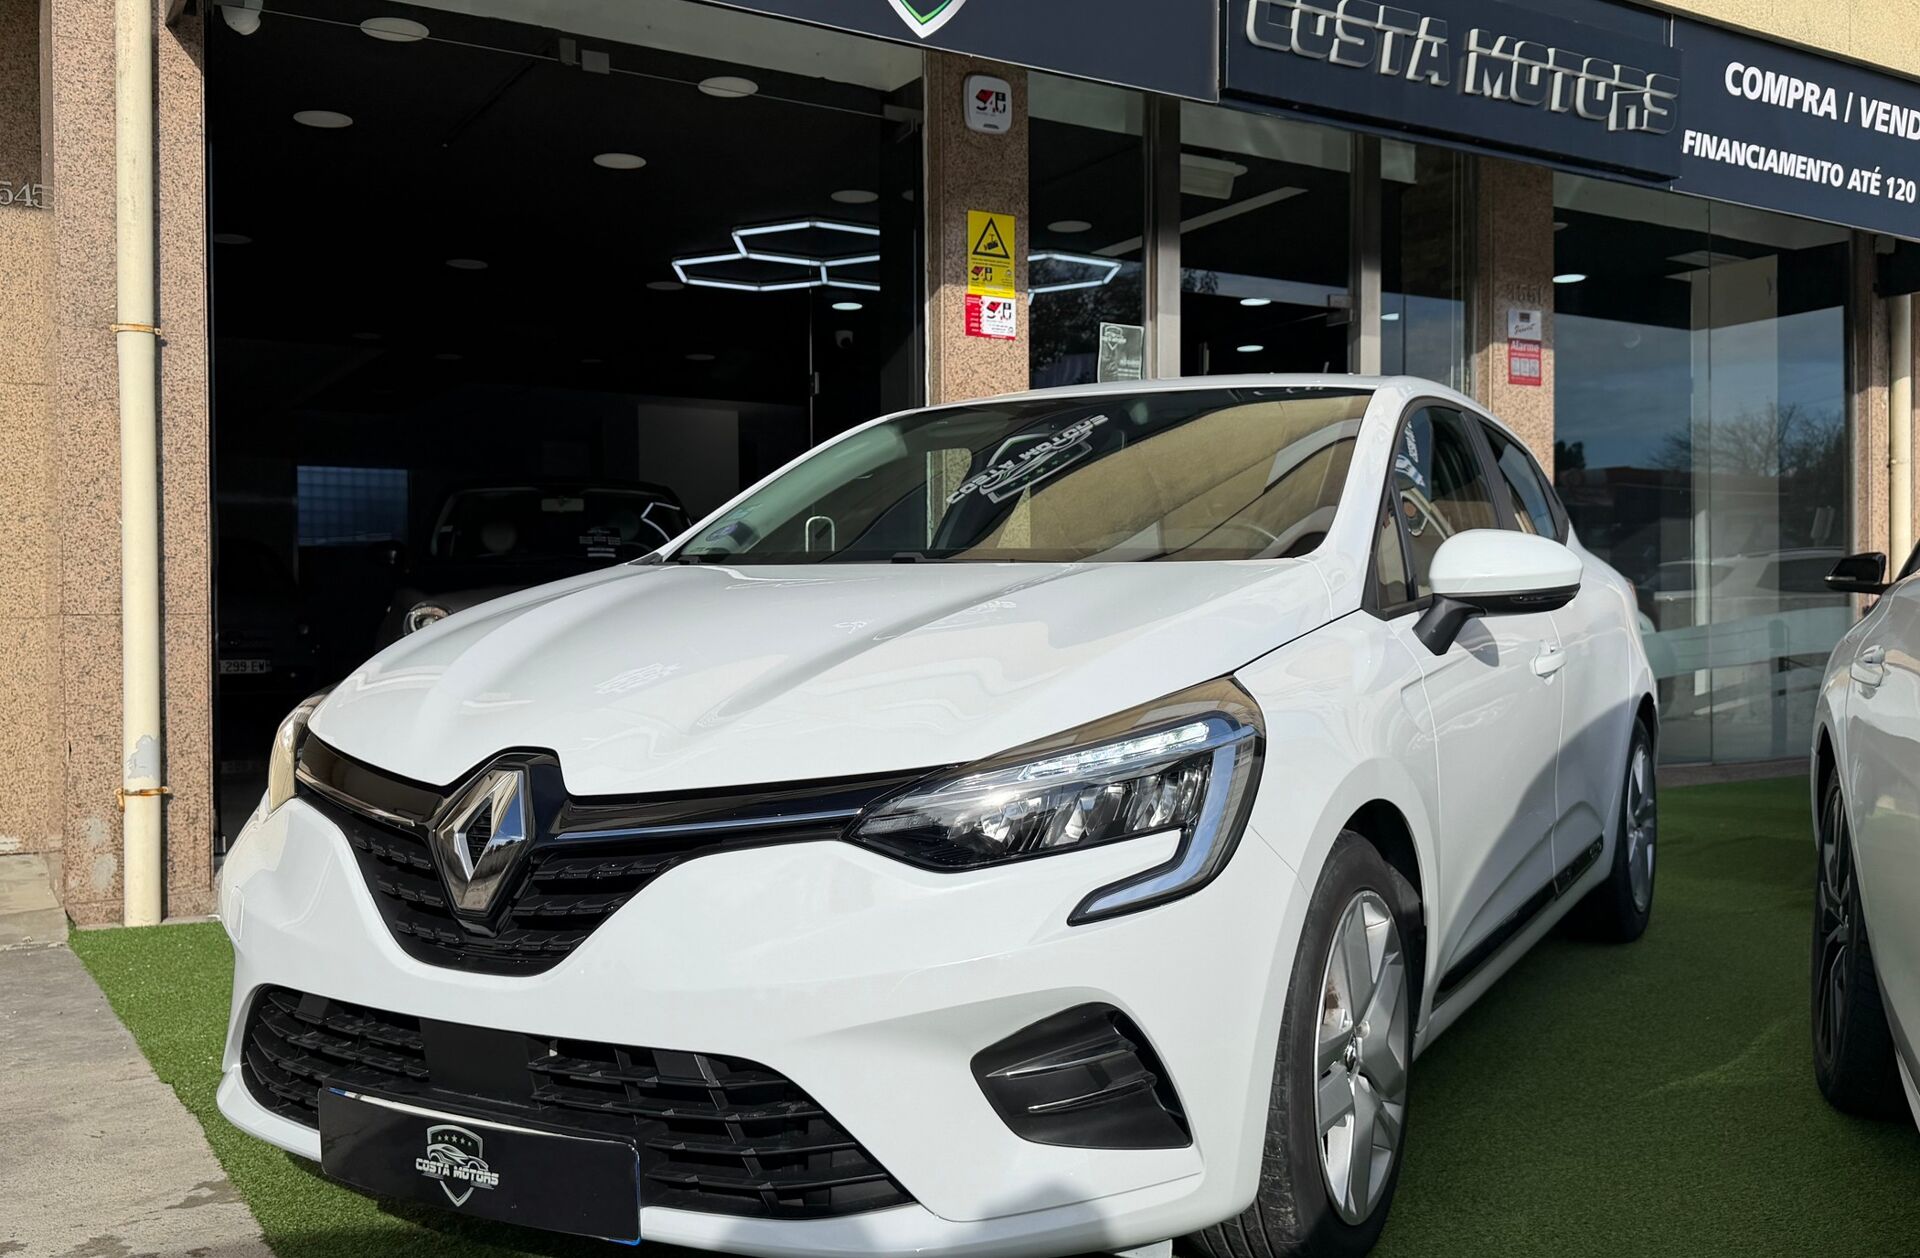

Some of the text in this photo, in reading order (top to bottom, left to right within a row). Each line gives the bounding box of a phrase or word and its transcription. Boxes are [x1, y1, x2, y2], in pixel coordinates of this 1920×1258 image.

[1246, 0, 1680, 134] COSTA MOTORS
[1725, 61, 1837, 120] COMPRA
[1860, 96, 1920, 140] VEND
[1682, 129, 1916, 203] FINANCIAMENTO ATÉ 120
[416, 1158, 499, 1186] COSTA MOTORS
